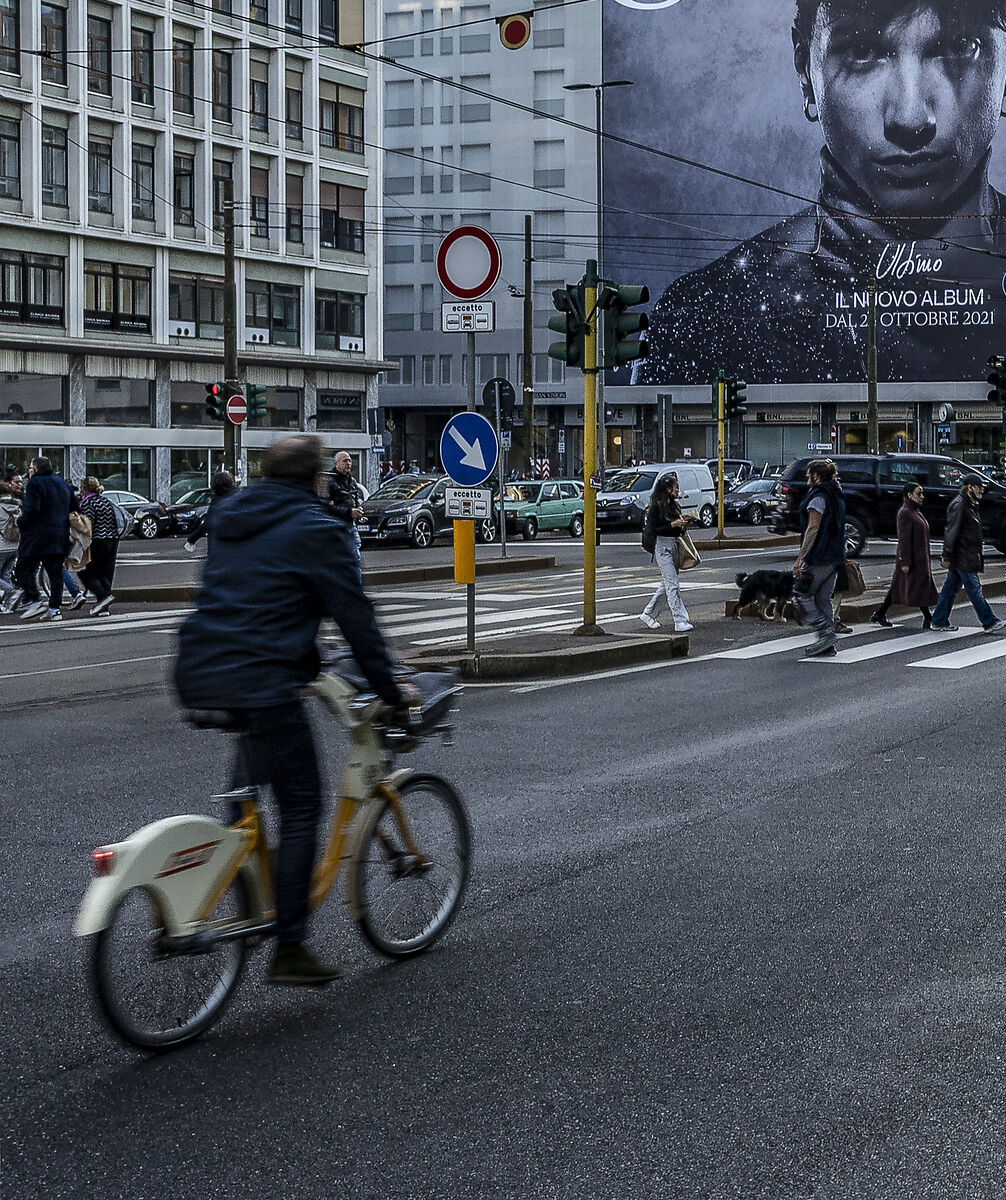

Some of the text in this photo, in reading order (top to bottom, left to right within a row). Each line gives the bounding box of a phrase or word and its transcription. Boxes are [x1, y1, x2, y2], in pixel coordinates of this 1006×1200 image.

[876, 241, 943, 279] Ultimo
[452, 304, 483, 312] eccetto
[835, 288, 984, 309] IL NUOVO ALBUM
[825, 313, 858, 329] DAL
[880, 311, 959, 328] OTTOBRE
[962, 310, 995, 326] 2021
[453, 491, 482, 499] eccetto
